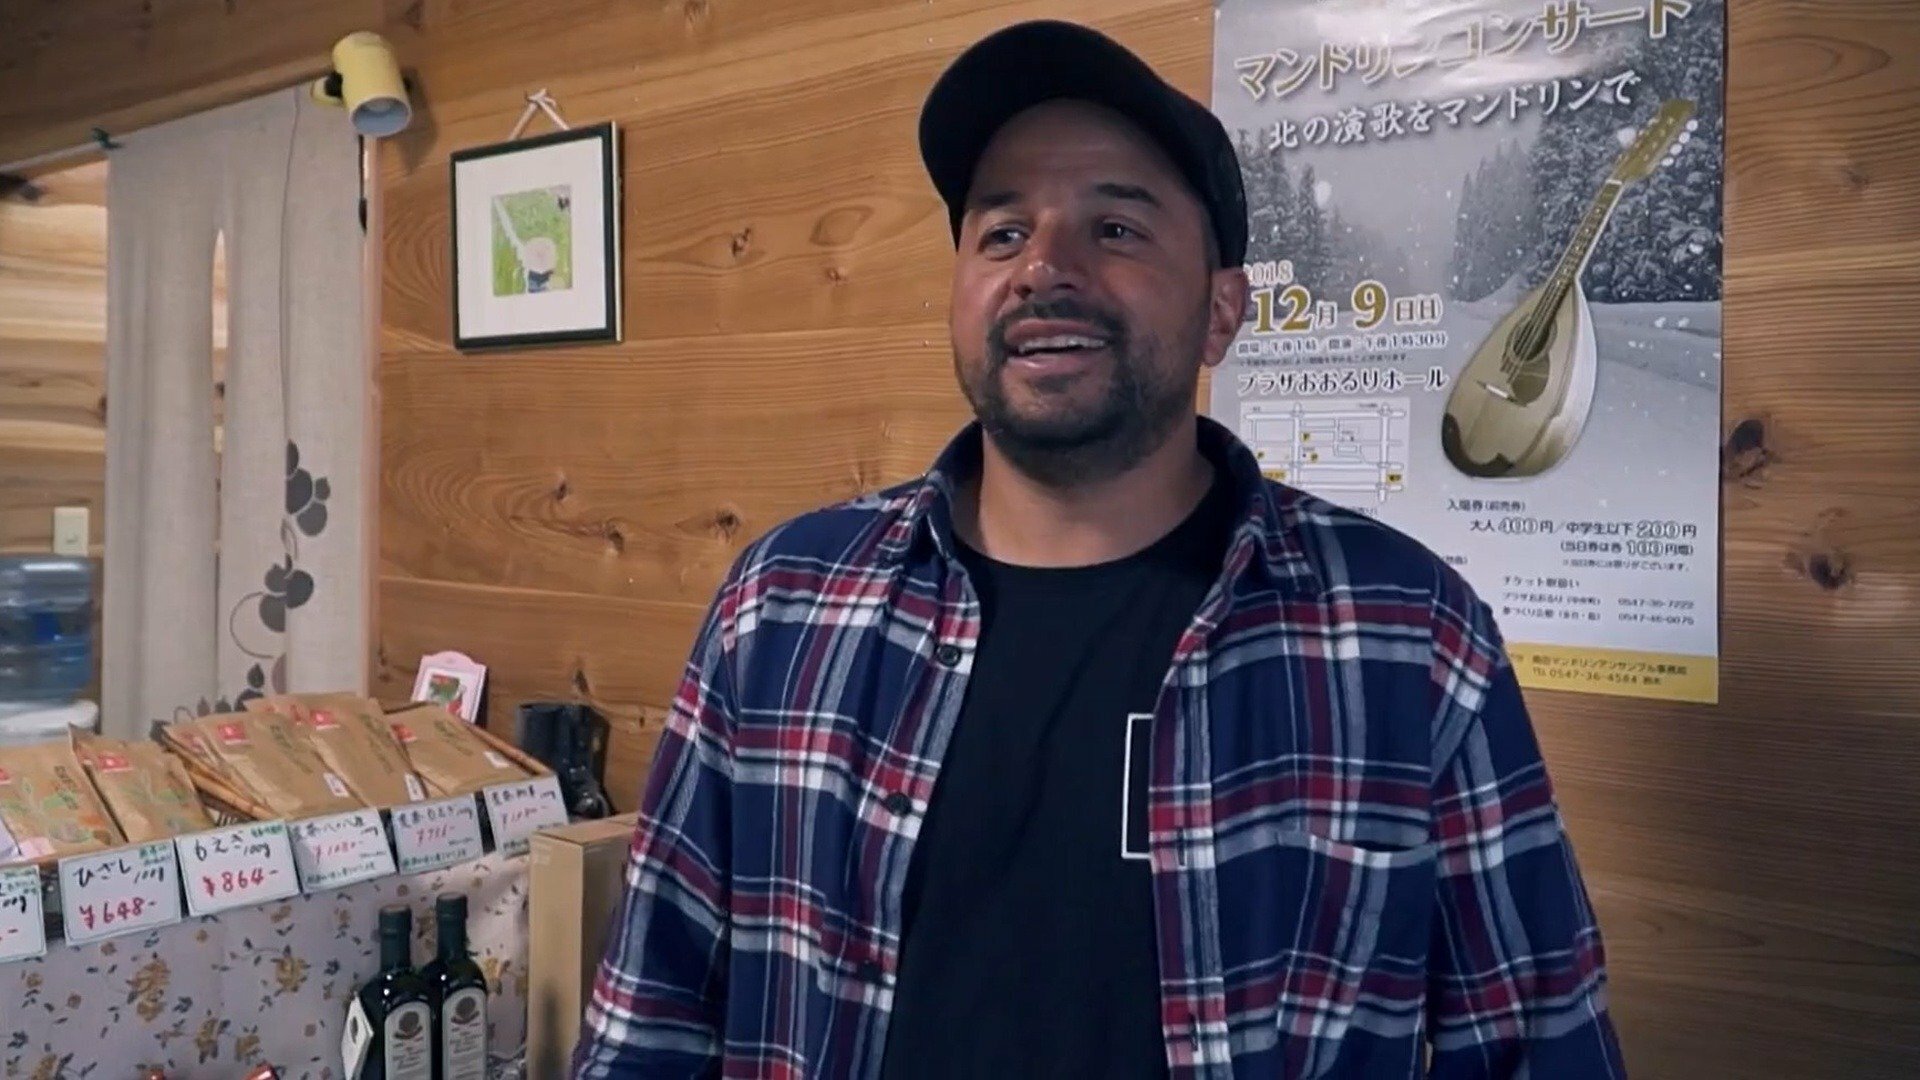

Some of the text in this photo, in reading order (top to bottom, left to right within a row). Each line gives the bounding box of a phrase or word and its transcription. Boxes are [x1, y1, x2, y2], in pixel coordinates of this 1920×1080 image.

[1269, 70, 1641, 150] 北の演歌をマンドリンで
[1243, 260, 1294, 286] 018
[1237, 367, 1448, 396] プラザおおるりホール
